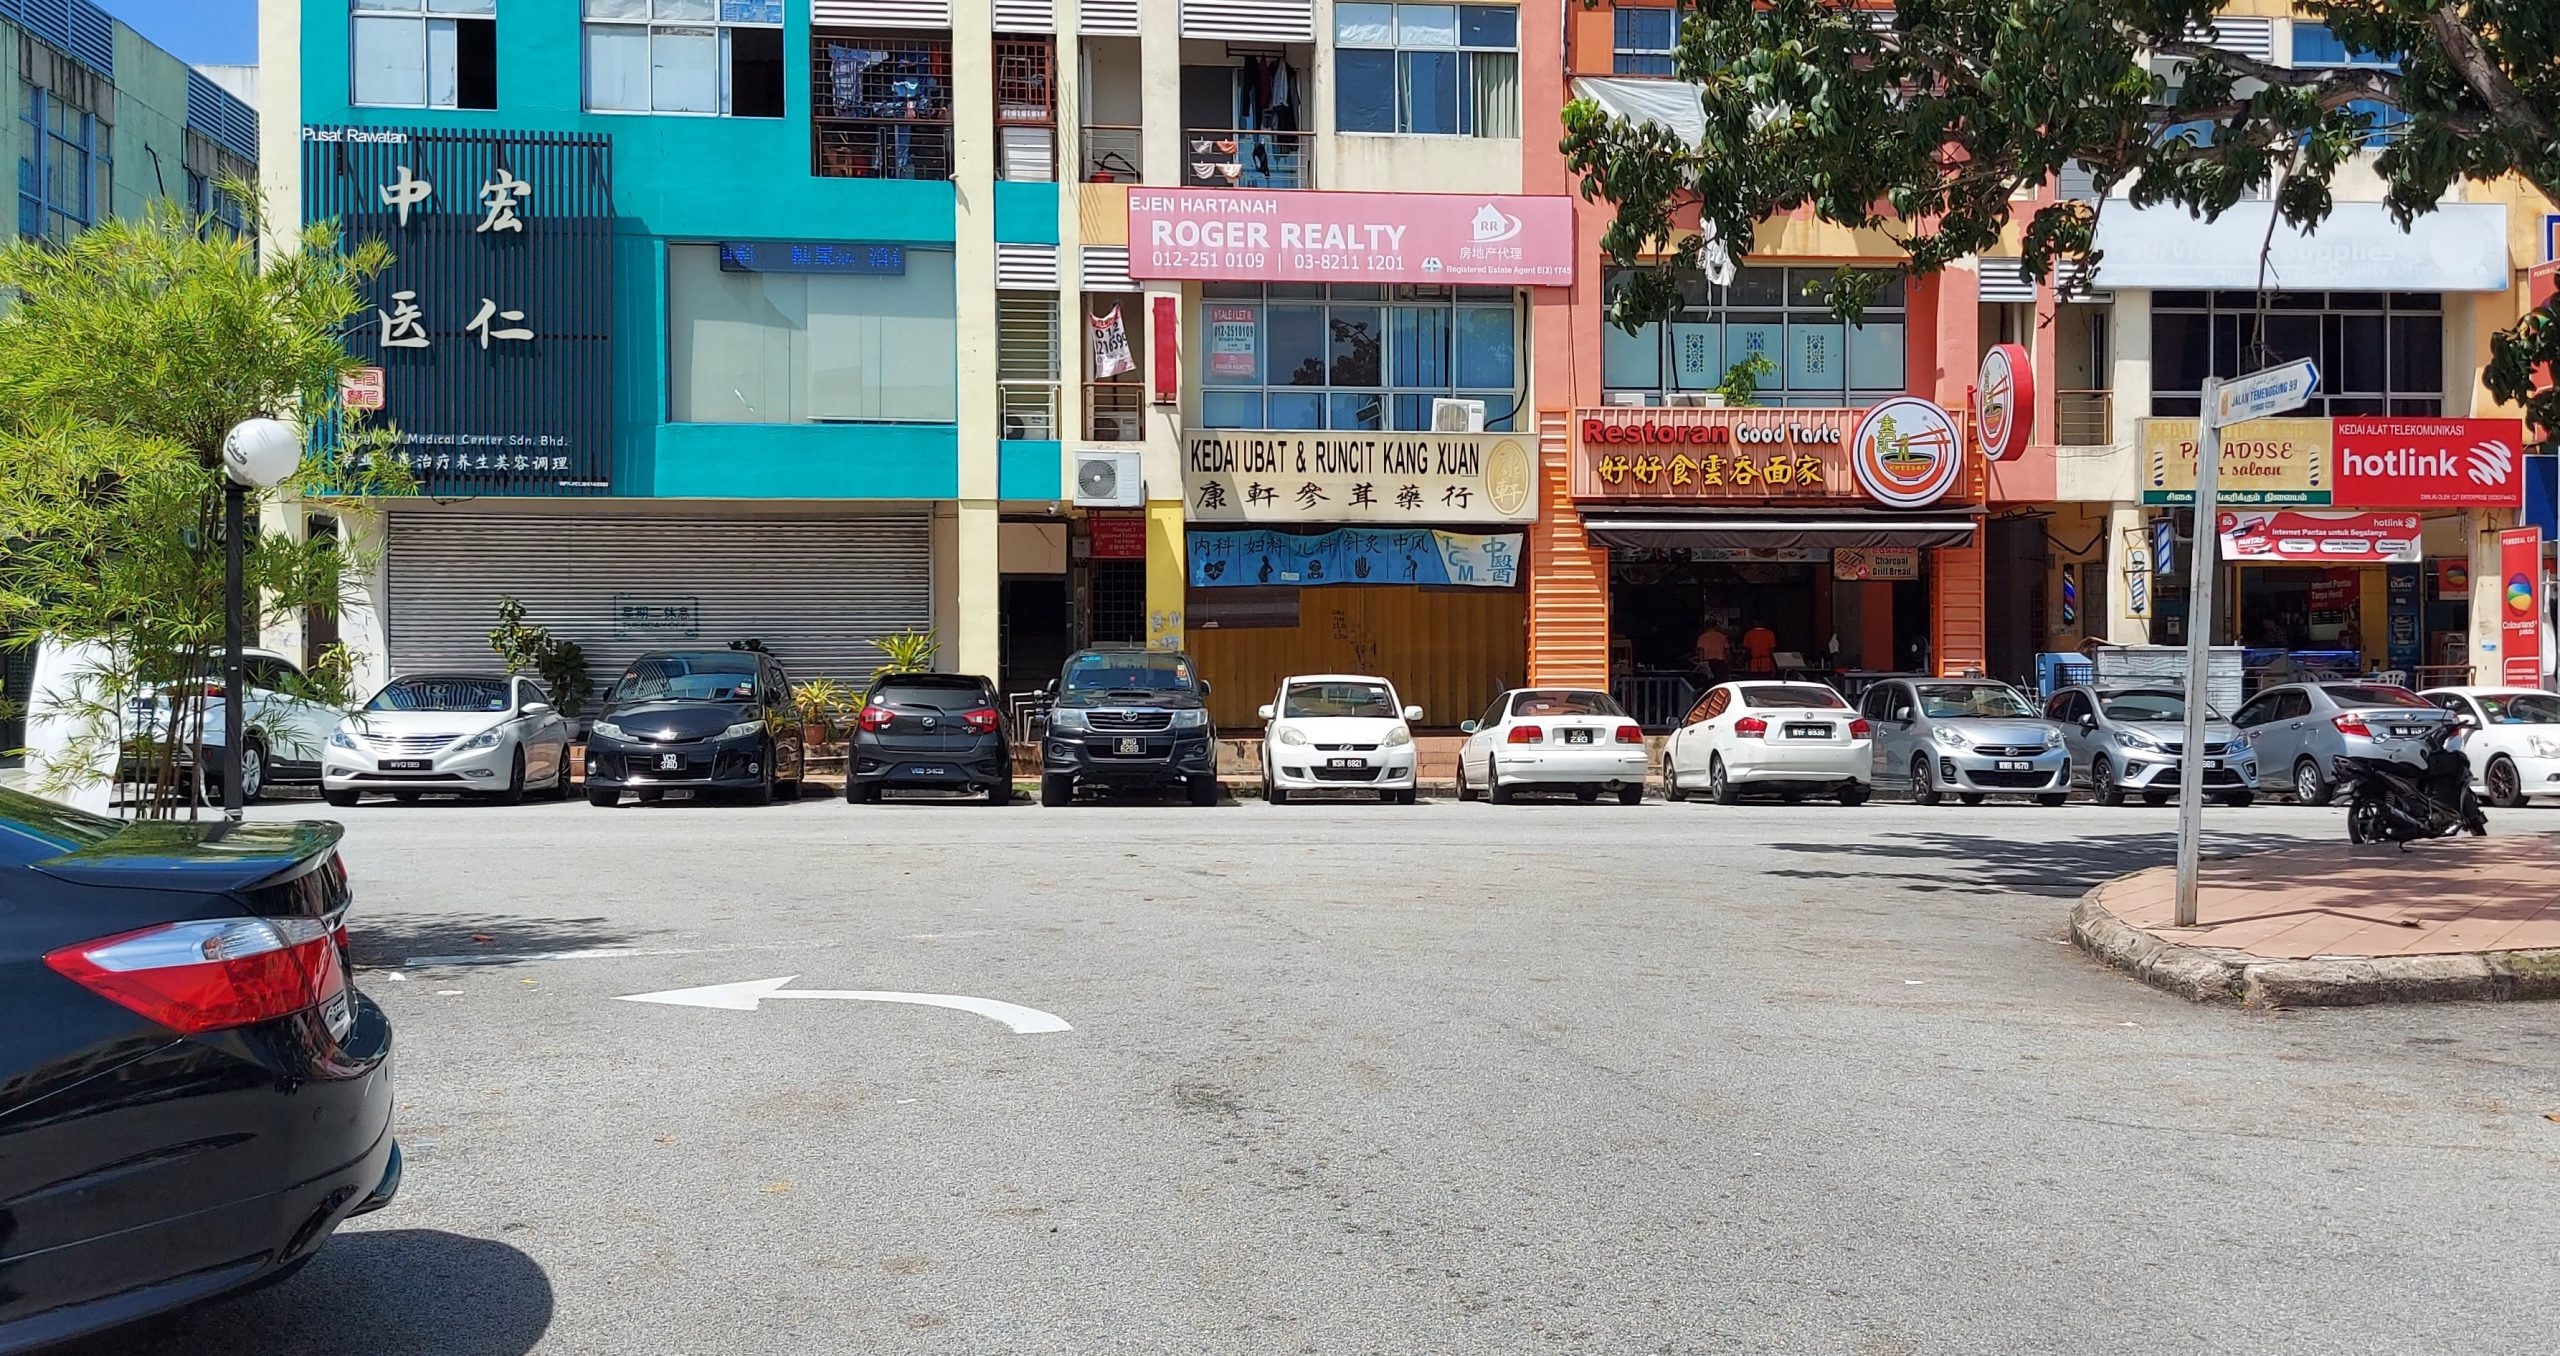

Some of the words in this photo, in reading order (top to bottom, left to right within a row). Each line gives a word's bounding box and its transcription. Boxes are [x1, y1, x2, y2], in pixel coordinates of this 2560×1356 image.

[302, 128, 342, 142] Pusat
[347, 129, 408, 144] Rawatan
[1129, 196, 1175, 211] EJEN
[1180, 197, 1277, 214] HARTANAH
[1151, 219, 1271, 249] ROGER
[1280, 223, 1407, 251] REALTY
[1480, 221, 1499, 231] RR
[1152, 251, 1219, 267] 012-251
[1225, 252, 1265, 268] 0109
[1294, 253, 1360, 270] 03-8211
[1367, 255, 1405, 271] 1201
[1459, 247, 1524, 262] 房地产代理
[1446, 265, 1486, 274] Registered
[1488, 266, 1512, 274] Estate
[1513, 266, 1536, 275] Agent
[2231, 392, 2249, 407] JALAN
[1582, 420, 1730, 445] Restoran
[1736, 422, 1785, 444] Good
[1789, 422, 1842, 445] Taste
[2338, 423, 2365, 436] KEDAI
[2366, 424, 2388, 436] ALAT
[2389, 424, 2465, 436] TELEKOMUNIKASI
[407, 433, 455, 445] Medical
[461, 433, 503, 446] Center
[540, 435, 568, 447] Bhd.
[1190, 439, 1239, 473] KEDAI
[1243, 440, 1287, 474] UBAT
[1295, 441, 1307, 474] &
[1315, 441, 1375, 475] RUNCIT
[1383, 441, 1429, 475] KANG
[1436, 442, 1480, 475] XUAN
[2342, 447, 2459, 477] hotlink
[1597, 453, 1825, 487] 好好食雲吞面家
[2373, 518, 2404, 528] hotlink
[2272, 528, 2301, 536] Internet
[2350, 529, 2387, 538] Segalanya
[1194, 536, 1235, 558] 内科
[1244, 536, 1287, 556] 妇科
[1294, 537, 1337, 556] 儿科
[1343, 534, 1382, 554] 针灸
[1393, 534, 1429, 555] 中风
[1481, 536, 1516, 585] 中醫
[1875, 556, 1909, 565] Charcoal
[1889, 567, 1911, 576] Bread
[2311, 581, 2332, 589] Internet
[2333, 579, 2352, 588] Pantas
